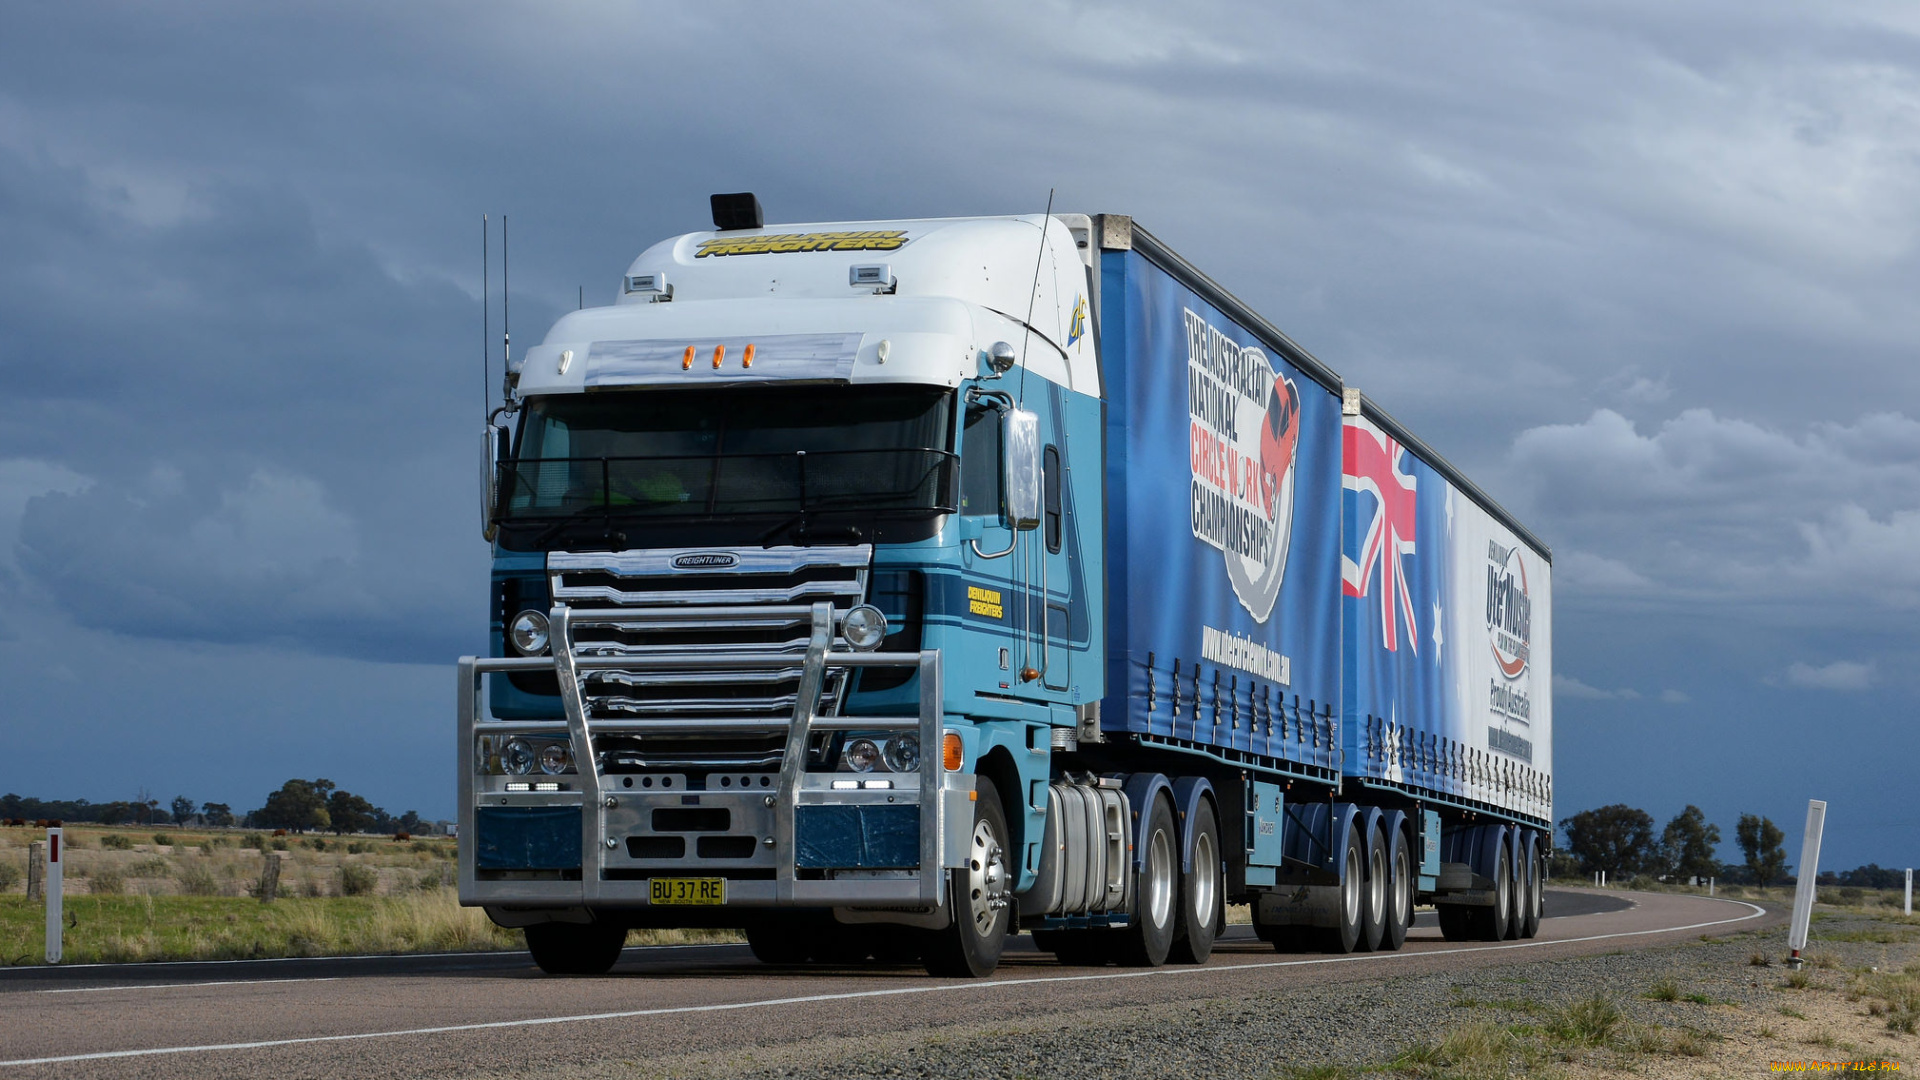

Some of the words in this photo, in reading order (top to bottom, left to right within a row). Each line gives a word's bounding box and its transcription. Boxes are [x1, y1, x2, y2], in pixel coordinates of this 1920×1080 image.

[695, 237, 909, 258] FREIGHTERS
[1185, 311, 1207, 369] THE
[1208, 327, 1267, 410] AUSTRALIAN
[1189, 365, 1238, 443] NATIONAL
[1191, 422, 1225, 490] CIRCLE
[1227, 446, 1259, 508] WORK
[1192, 480, 1269, 567] CHAMPIONSHIPS
[677, 556, 732, 565] FREIGHTLINER
[970, 600, 1003, 619] FREIGHTERS
[653, 881, 672, 899] BU
[677, 881, 695, 899] 37
[701, 881, 720, 899] RE
